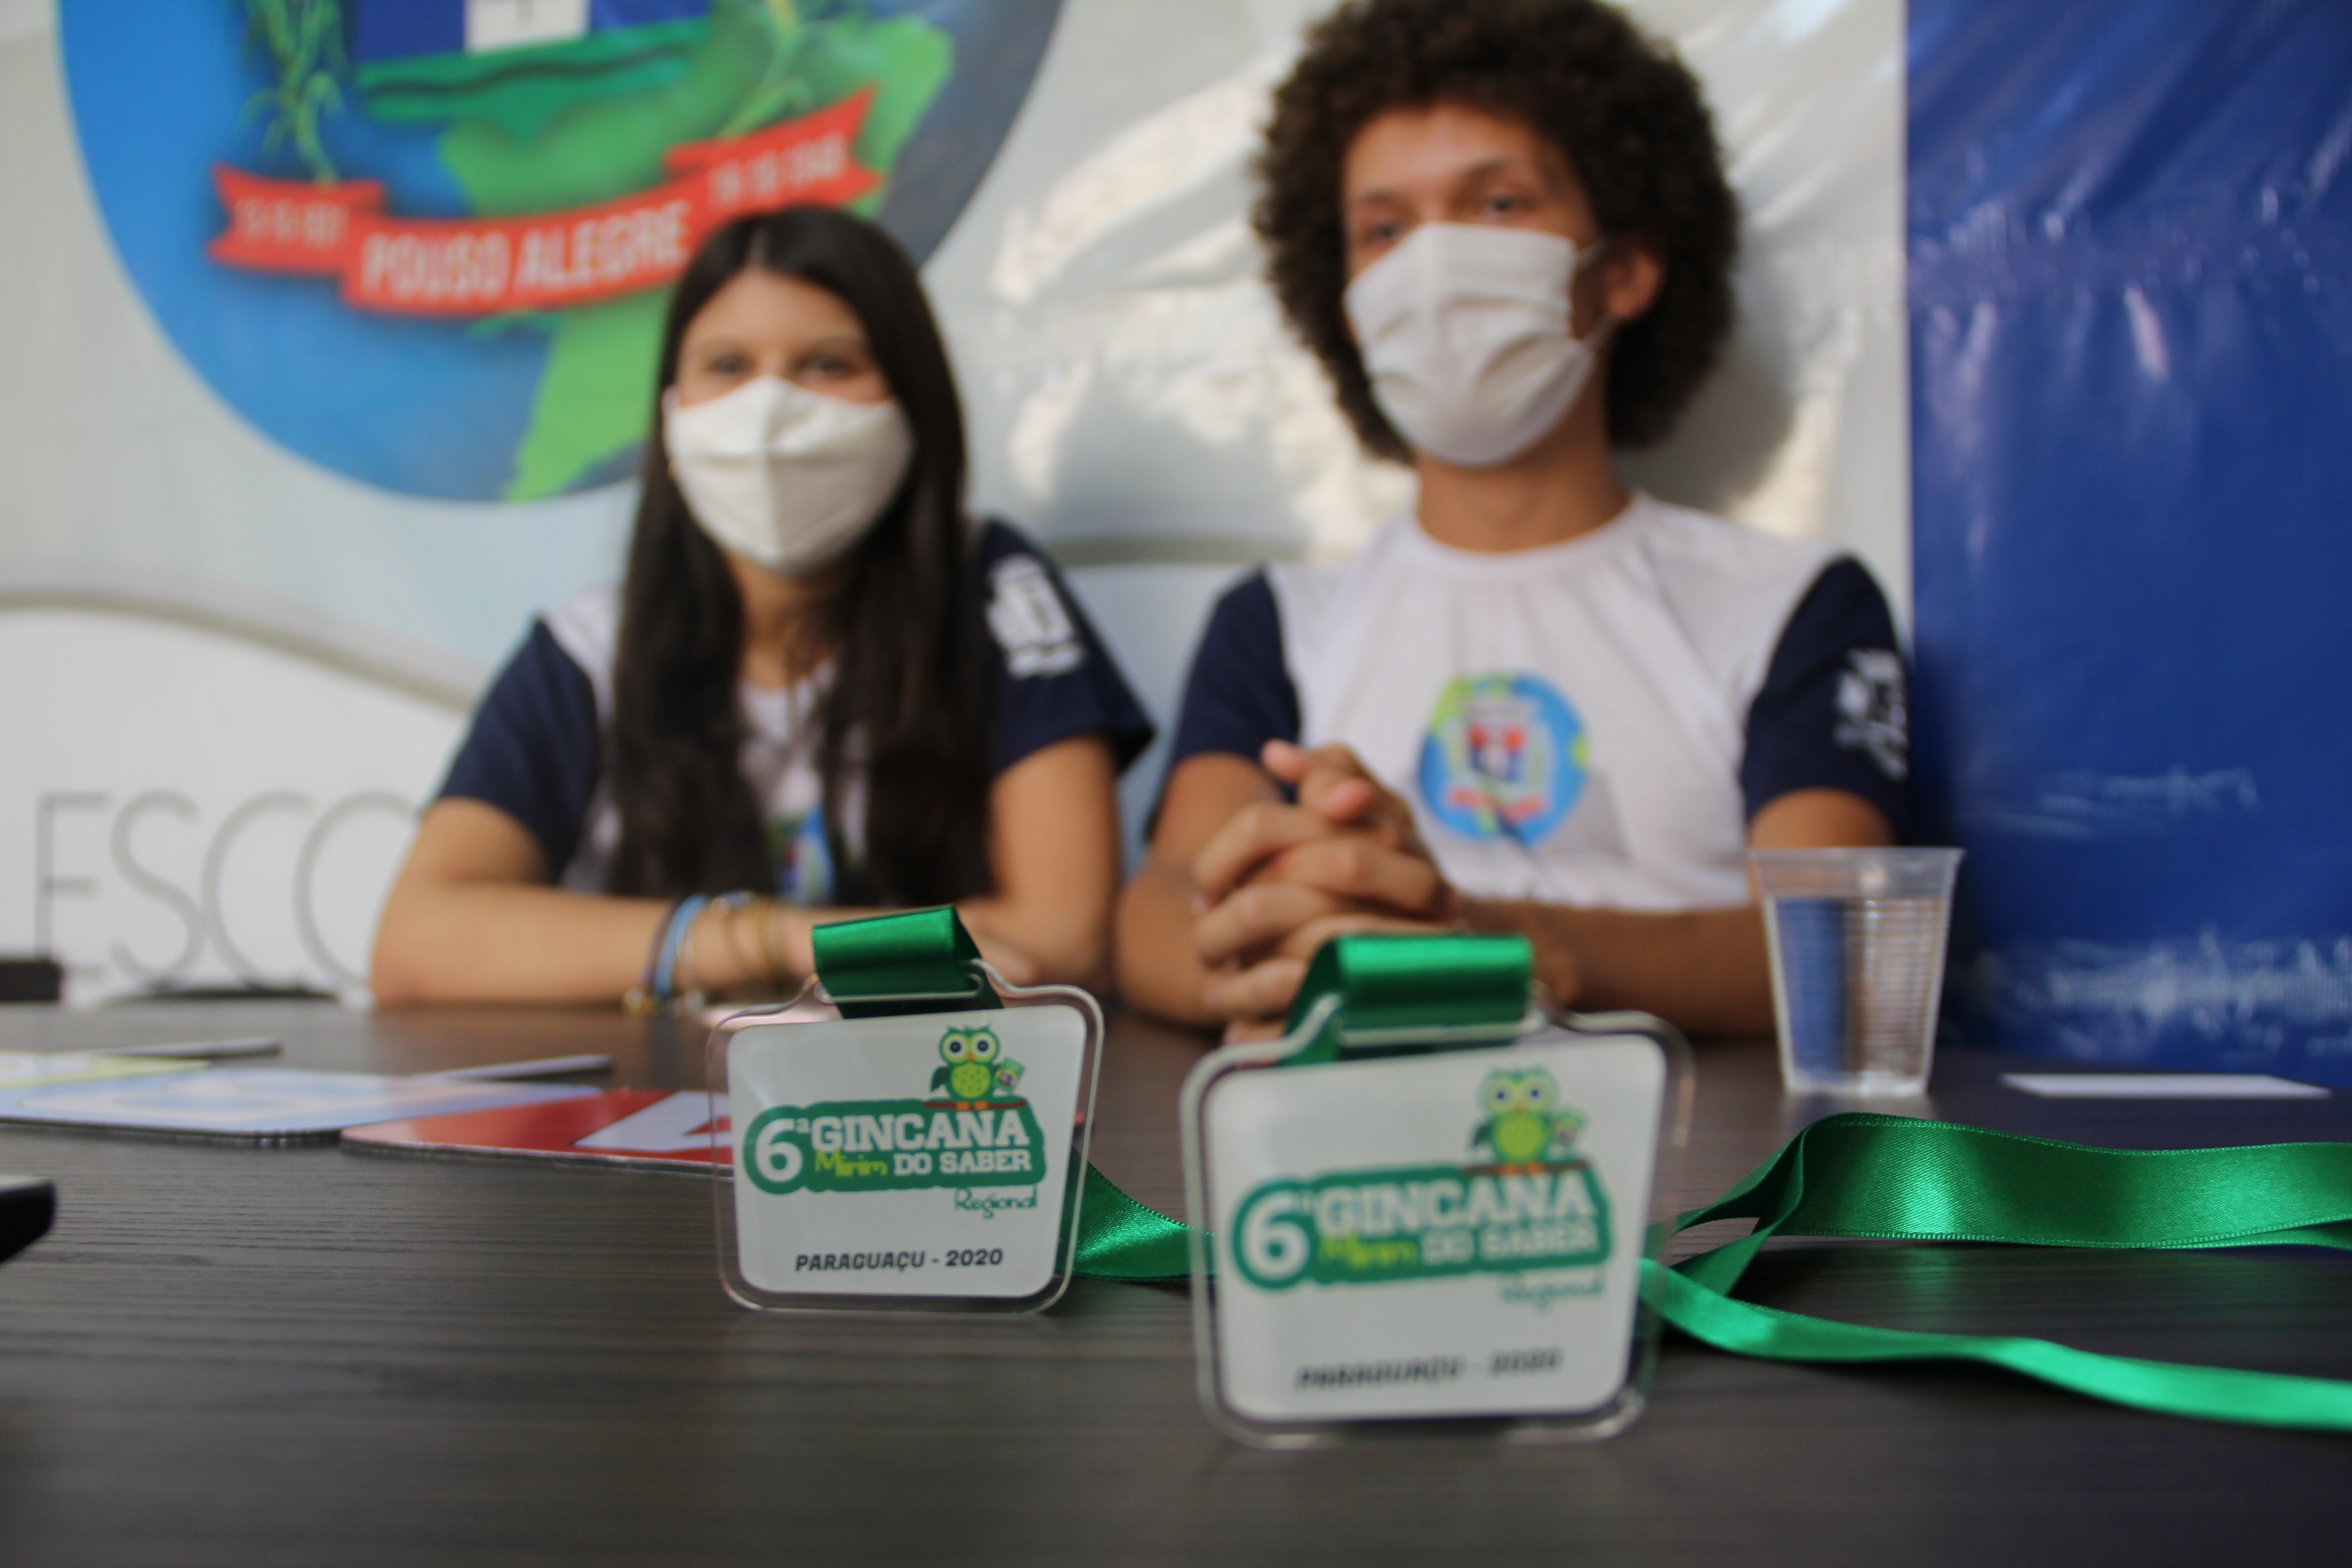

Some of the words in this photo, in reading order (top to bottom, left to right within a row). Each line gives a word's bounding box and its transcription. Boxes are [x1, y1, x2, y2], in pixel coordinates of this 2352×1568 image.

[361, 232, 511, 303] POUSO
[513, 198, 692, 293] ALEGRE
[810, 1110, 1030, 1152] GINCANA
[893, 1152, 932, 1176] DO
[939, 1150, 1033, 1174] SABER
[954, 1183, 1038, 1220] Regional
[1317, 1173, 1596, 1235] GINCANA
[795, 1250, 926, 1272] PARAGUAÇU
[945, 1248, 1004, 1266] 2020
